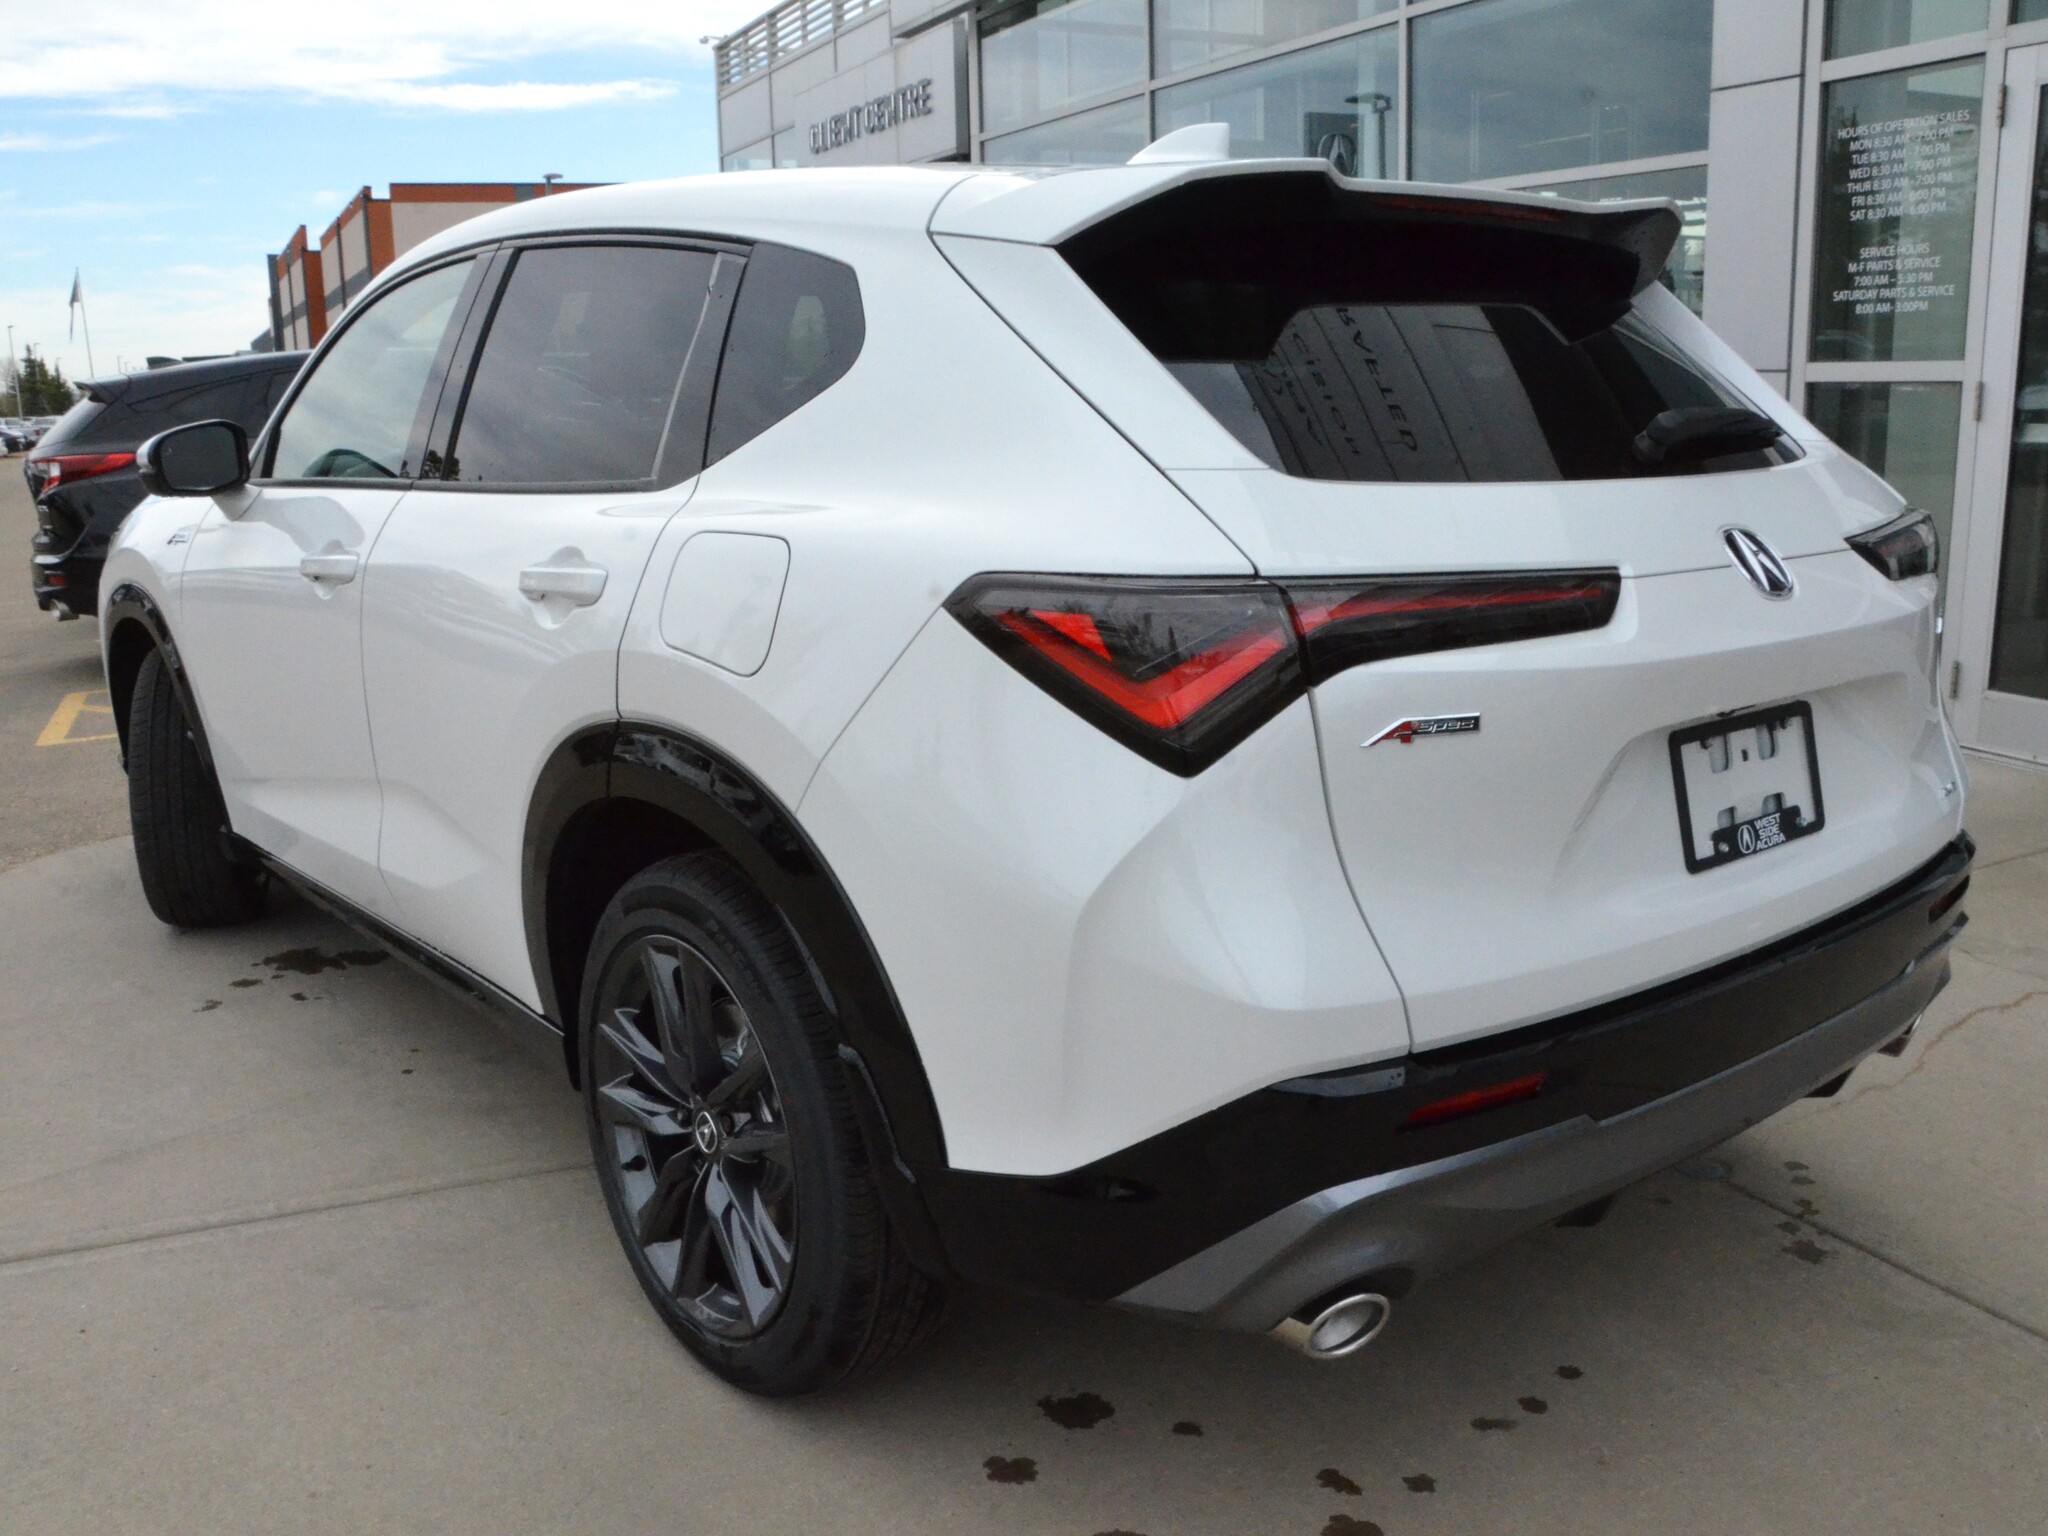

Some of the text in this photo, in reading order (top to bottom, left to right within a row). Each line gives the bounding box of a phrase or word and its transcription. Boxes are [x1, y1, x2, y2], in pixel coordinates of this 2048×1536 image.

[810, 78, 933, 154] CLIENT CENTRE
[1838, 109, 1970, 139] HOURS OF OPERATION SALES
[1850, 139, 1872, 151] MON
[1874, 136, 1892, 148] 8:30
[1894, 133, 1909, 145] AM
[1938, 126, 1953, 138] PM
[1852, 153, 1869, 165] TUE
[1871, 150, 1889, 162] 8:30
[1891, 148, 1906, 160] AM
[1935, 142, 1950, 153] PM
[1849, 168, 1870, 179] WED
[1872, 165, 1890, 177] 8:30
[1892, 163, 1907, 174] AM
[1936, 157, 1951, 168] PM
[1847, 182, 1871, 193] THUR
[1873, 179, 1891, 191] 8:30
[1893, 177, 1909, 188] AM
[1916, 174, 1935, 186] 7:00
[1937, 171, 1953, 182] PM
[1852, 196, 1865, 207] FRI
[1867, 194, 1885, 205] 8:30
[1887, 192, 1903, 203] AM
[1931, 187, 1946, 198] PM
[1850, 210, 1866, 221] SAT
[1867, 208, 1886, 219] 8:30
[1887, 206, 1903, 217] AM
[1931, 201, 1946, 213] PM
[1860, 243, 1930, 259] SERVICE HOURS
[1848, 256, 1941, 273] M-F PARTS & SERVICE
[1854, 275, 1873, 286] 7:00
[1873, 274, 1889, 285] AM
[1919, 271, 1933, 282] PM
[1832, 284, 1955, 302] SATURDAY PARTS & SERVICE
[1855, 303, 1874, 314] 8:00
[1754, 813, 1781, 829] WEST
[1756, 832, 1786, 851] ACURA
[1759, 824, 1780, 840] SIDE
